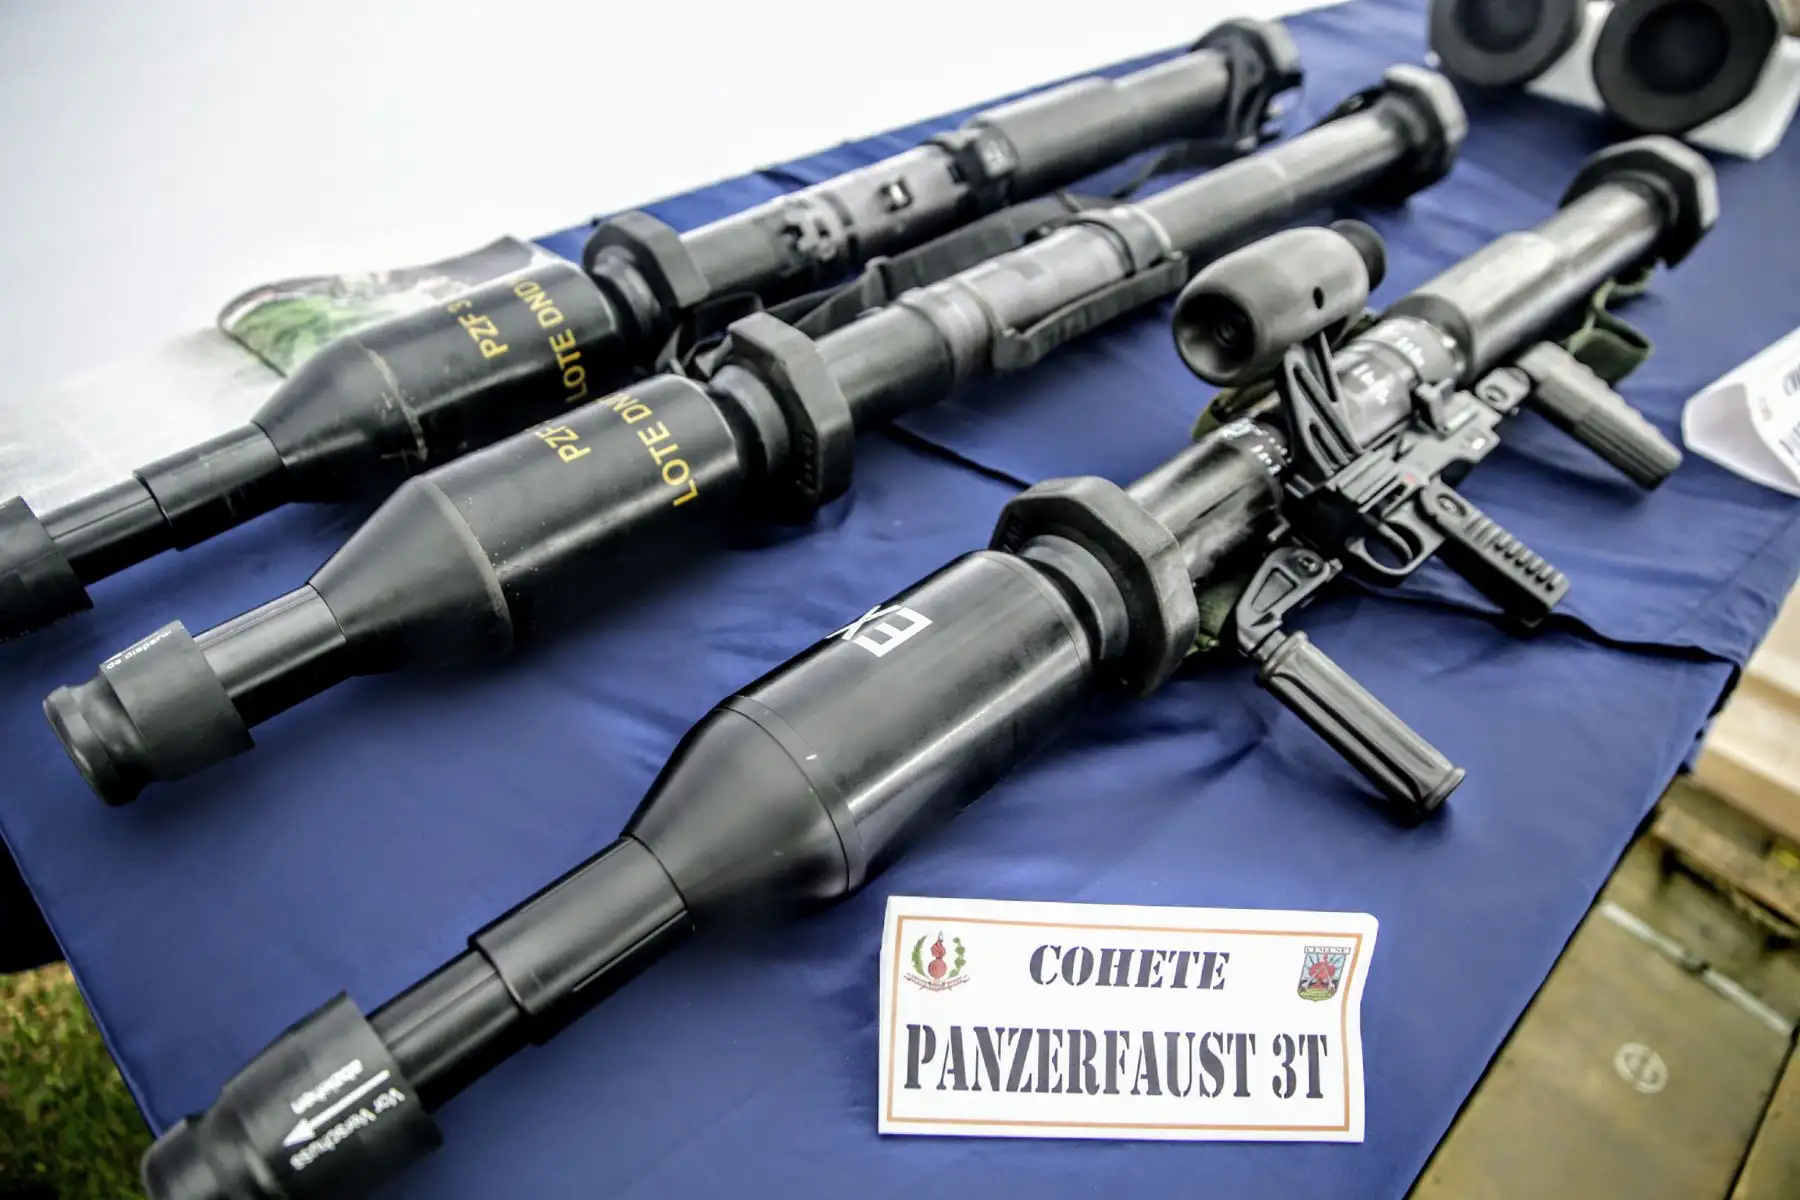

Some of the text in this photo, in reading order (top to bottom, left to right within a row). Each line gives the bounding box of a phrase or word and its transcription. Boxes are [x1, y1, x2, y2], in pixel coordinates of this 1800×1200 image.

[457, 312, 509, 360] PZF
[513, 276, 588, 403] LOTE DND
[636, 420, 699, 507] LOTE
[1028, 944, 1231, 990] COHETE
[903, 1023, 1328, 1100] PANZERFAUST 3T
